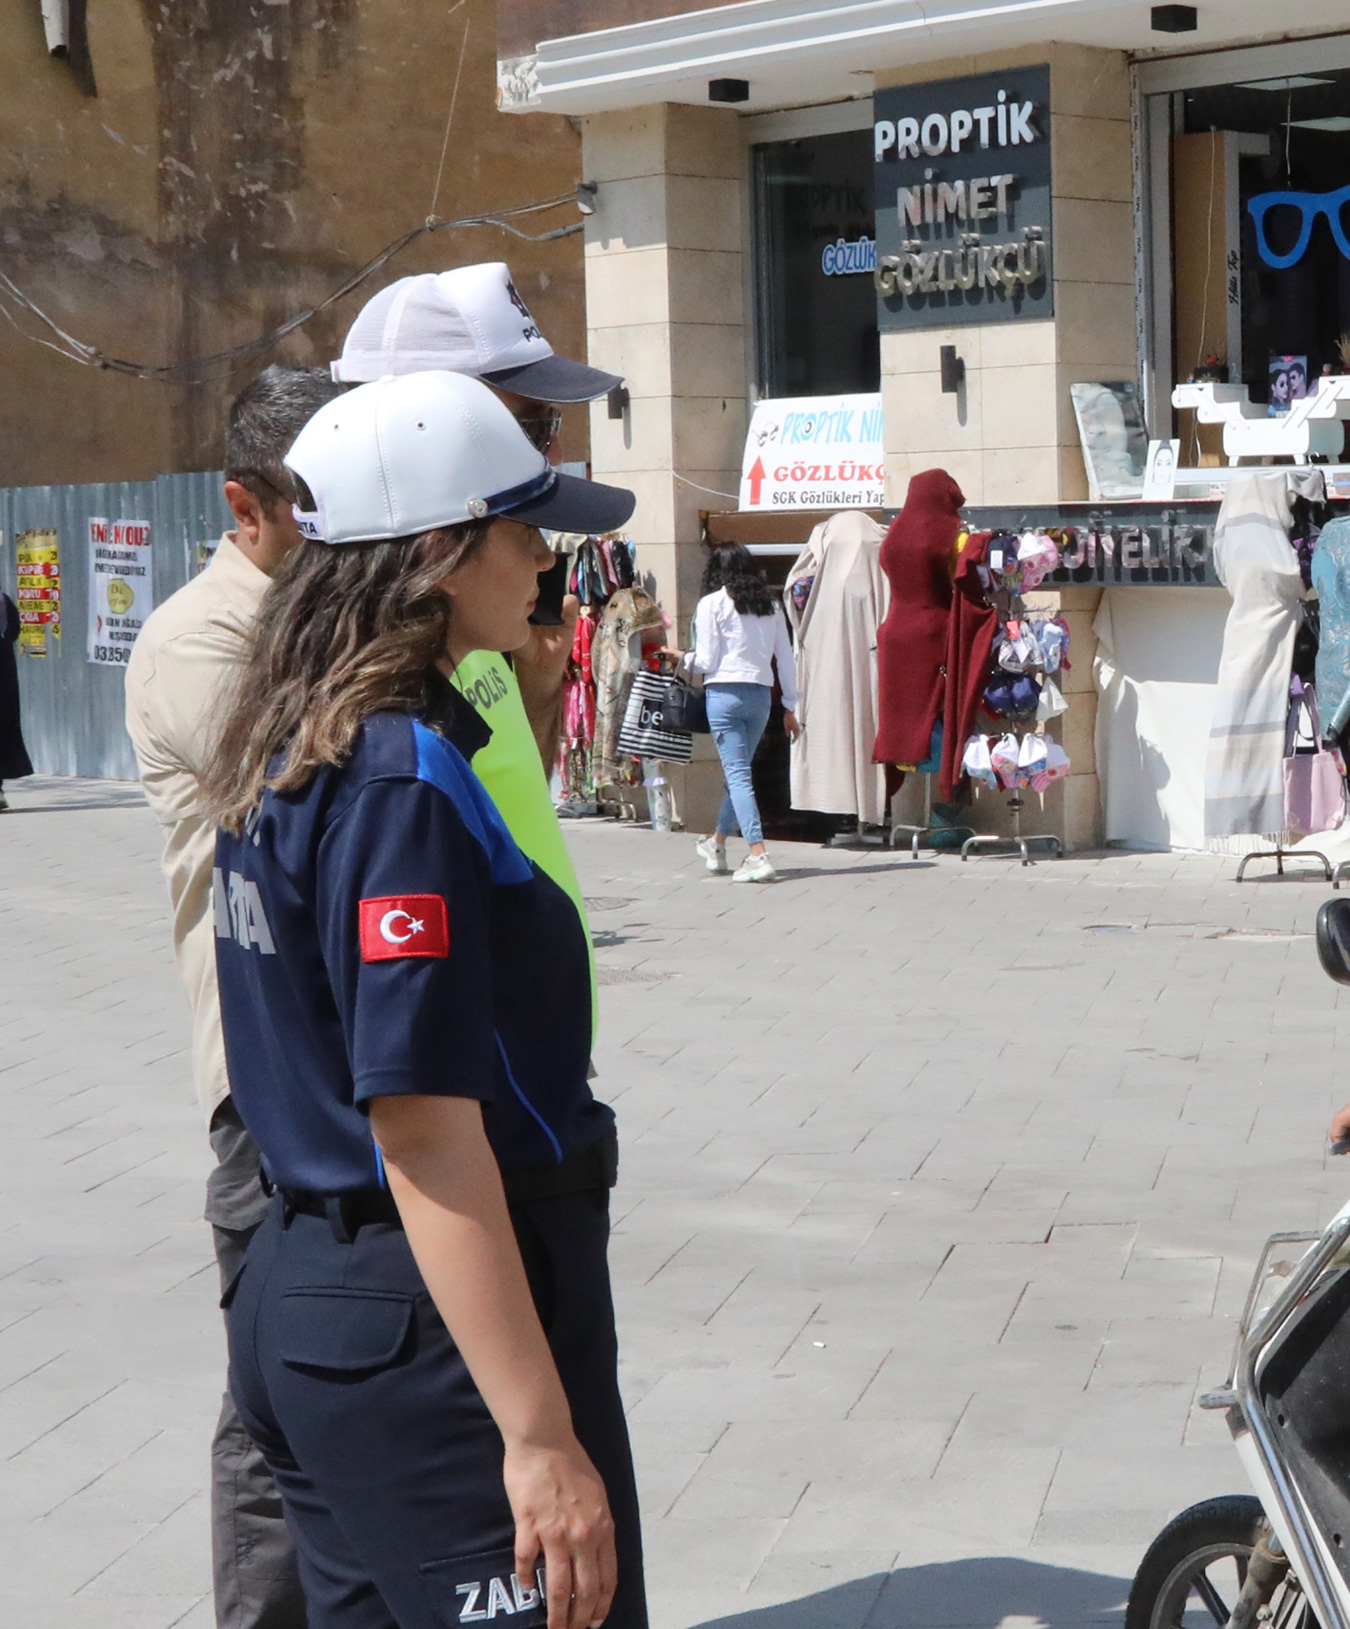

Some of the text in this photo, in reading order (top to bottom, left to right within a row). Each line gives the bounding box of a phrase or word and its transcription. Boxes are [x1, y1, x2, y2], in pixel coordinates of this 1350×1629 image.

[874, 89, 1034, 163] PROPTİK
[897, 167, 1016, 227] NİMET
[874, 226, 1047, 302] GÖZLÜKÇÜ
[780, 401, 854, 445] PROPTİK
[772, 491, 797, 505] SGK
[800, 490, 862, 505] Gözlükleri
